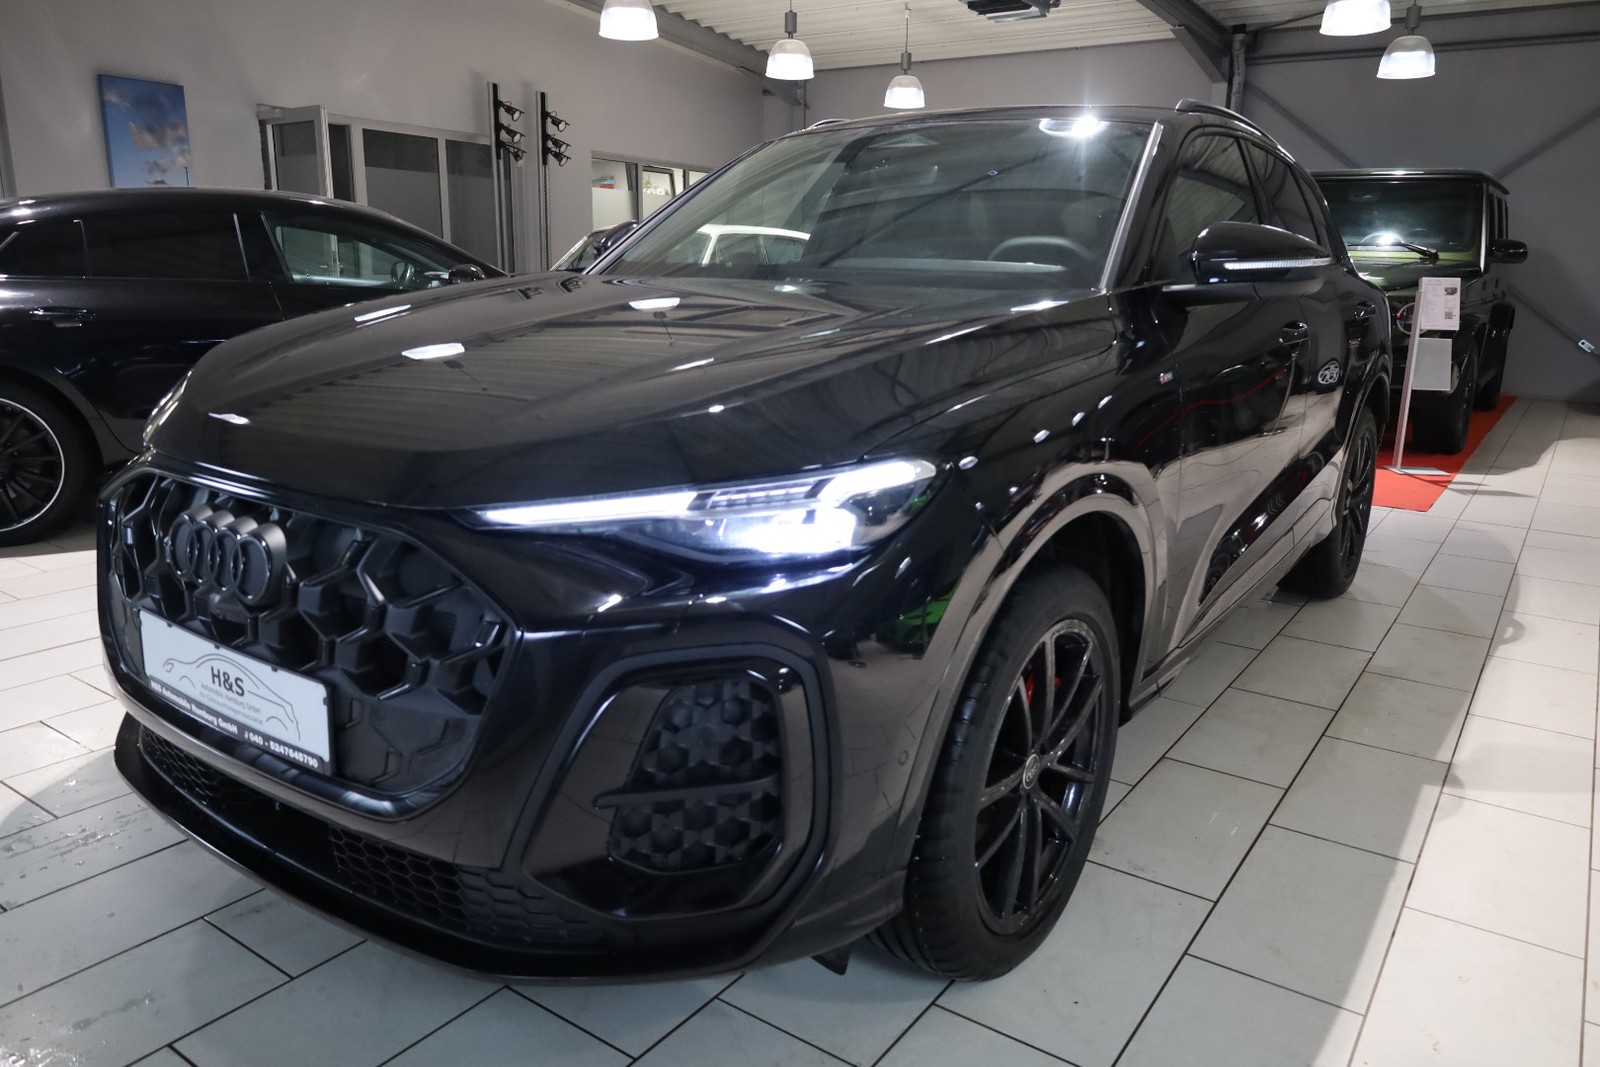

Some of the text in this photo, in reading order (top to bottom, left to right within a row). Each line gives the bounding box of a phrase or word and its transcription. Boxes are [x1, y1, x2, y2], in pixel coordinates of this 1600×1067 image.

[211, 665, 245, 697] H&S
[162, 686, 191, 710] Automobile
[191, 703, 218, 726] Hamburg
[218, 717, 238, 734] GmbH
